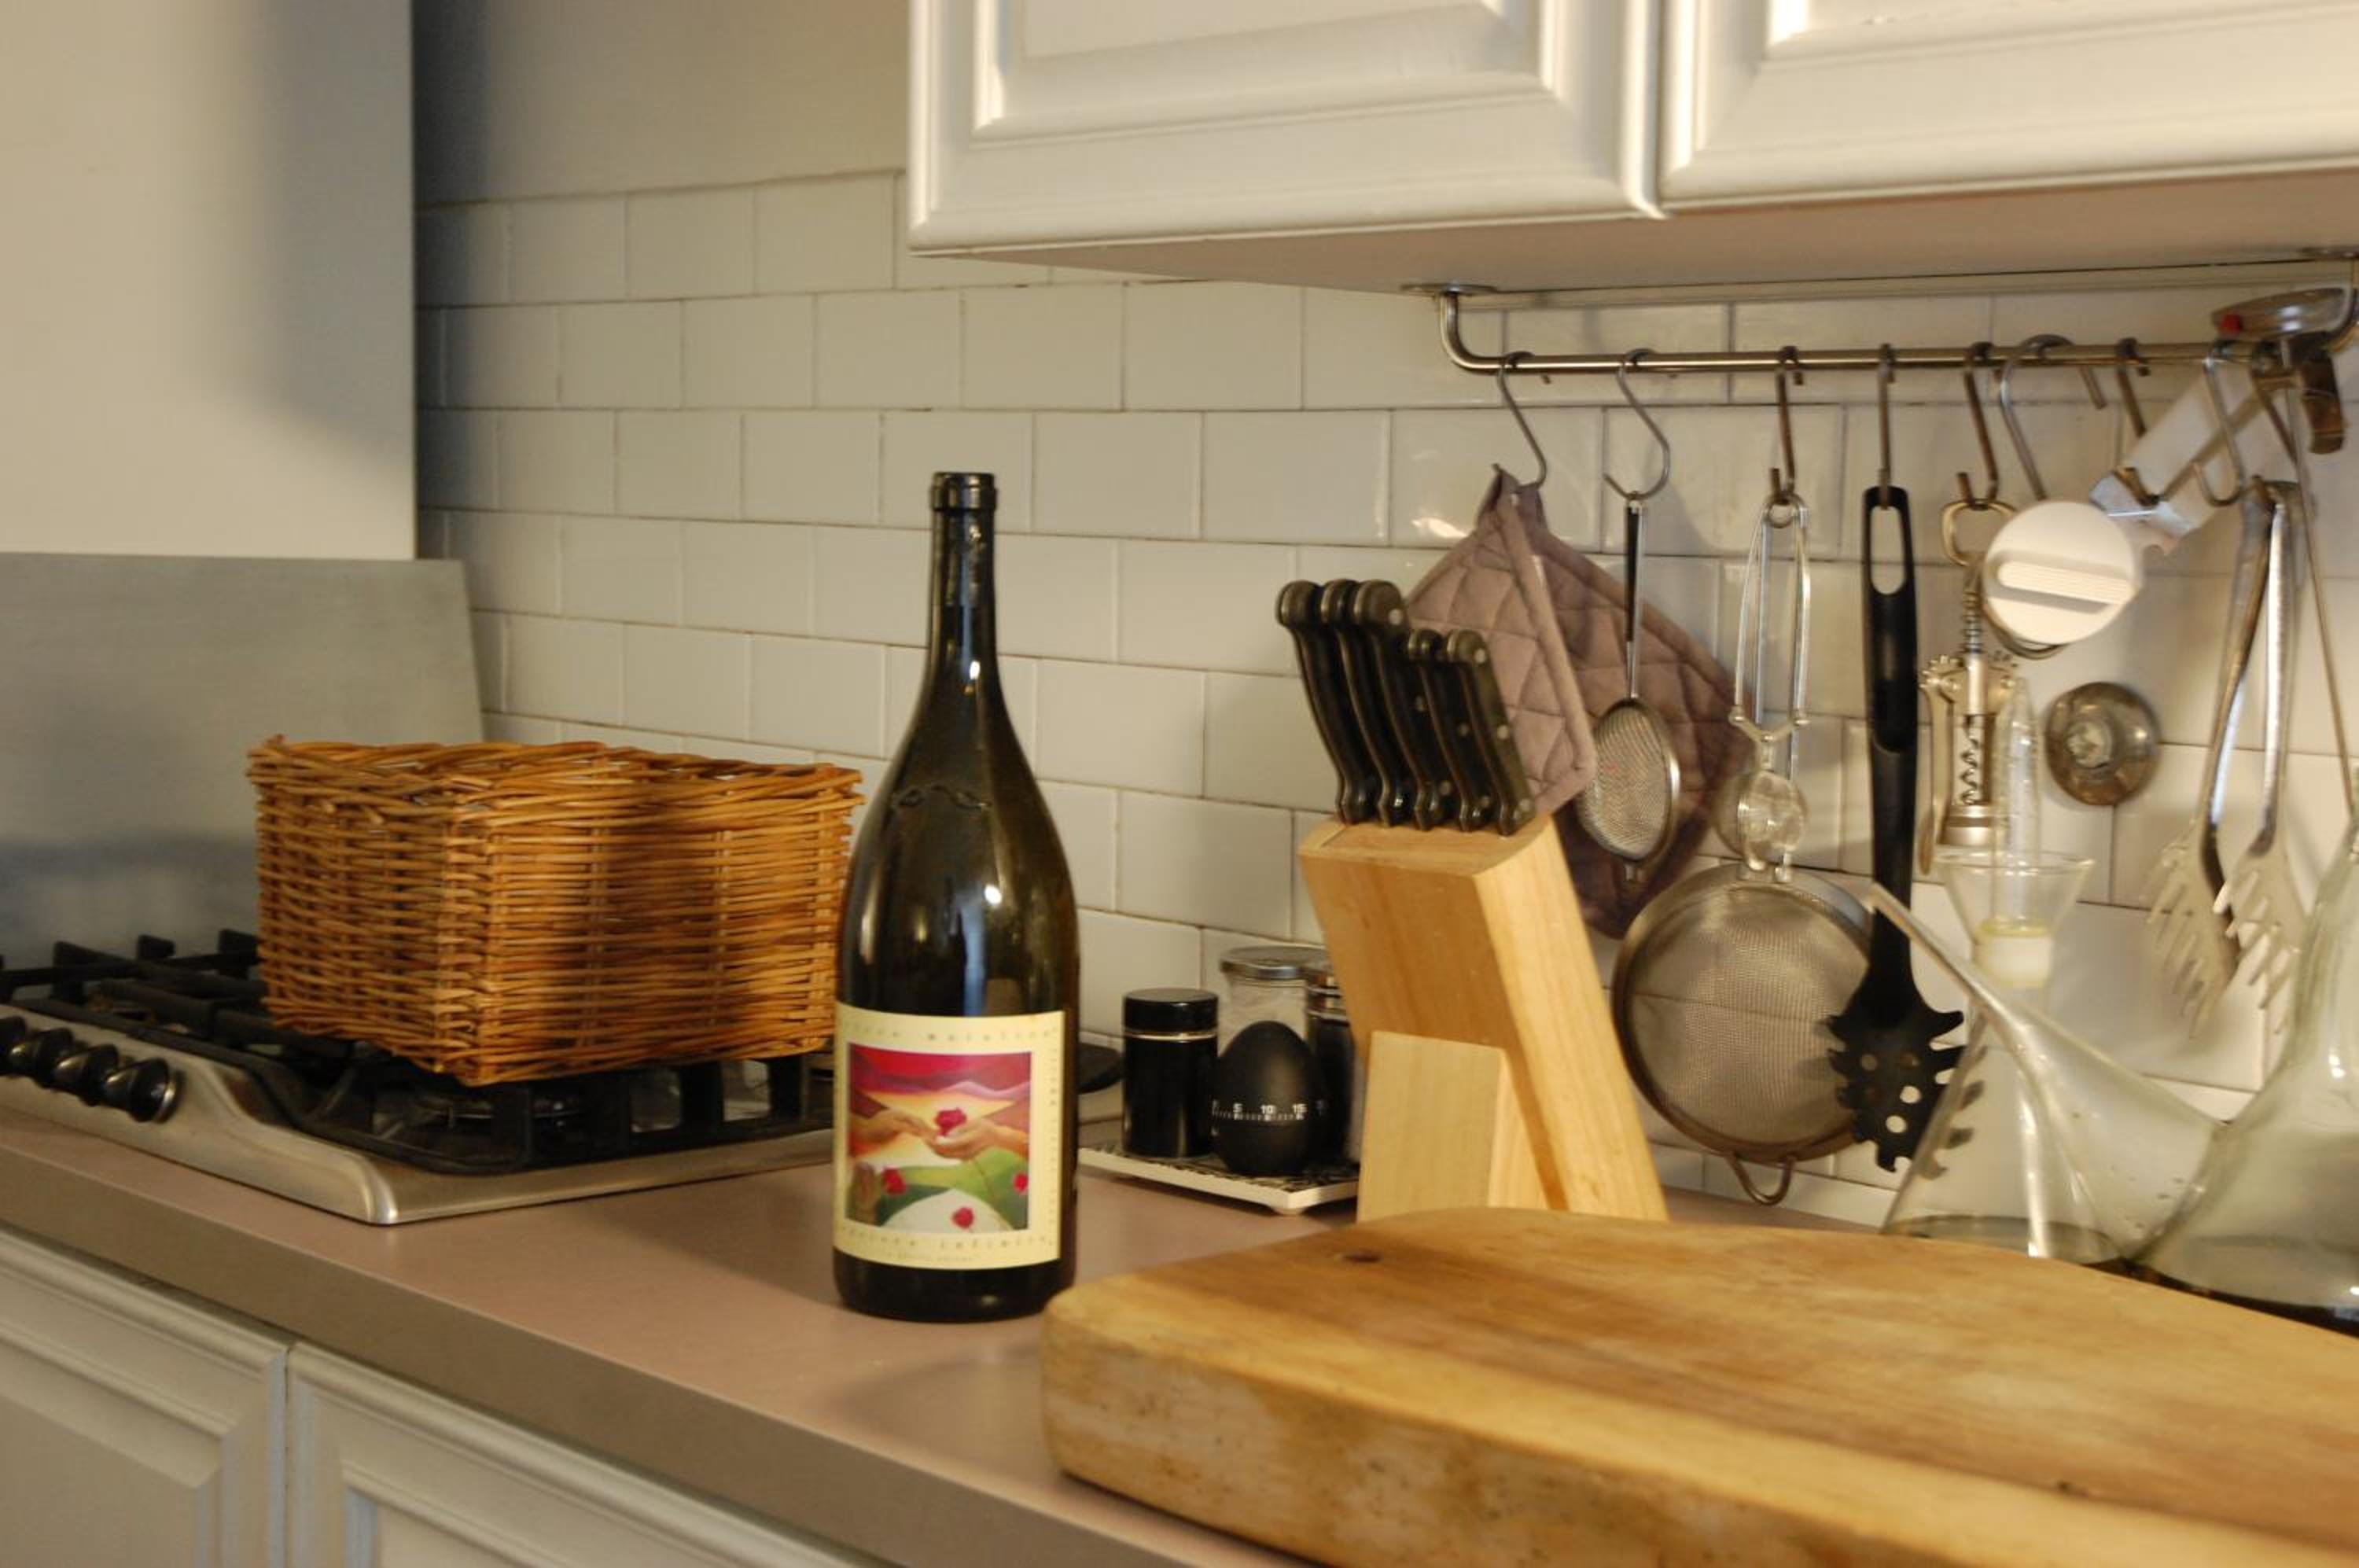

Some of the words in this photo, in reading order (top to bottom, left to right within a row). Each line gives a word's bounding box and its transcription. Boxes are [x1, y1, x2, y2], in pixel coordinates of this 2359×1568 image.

[1233, 1103, 1243, 1113] 5
[1260, 1104, 1275, 1114] 10
[1292, 1103, 1308, 1113] 15
